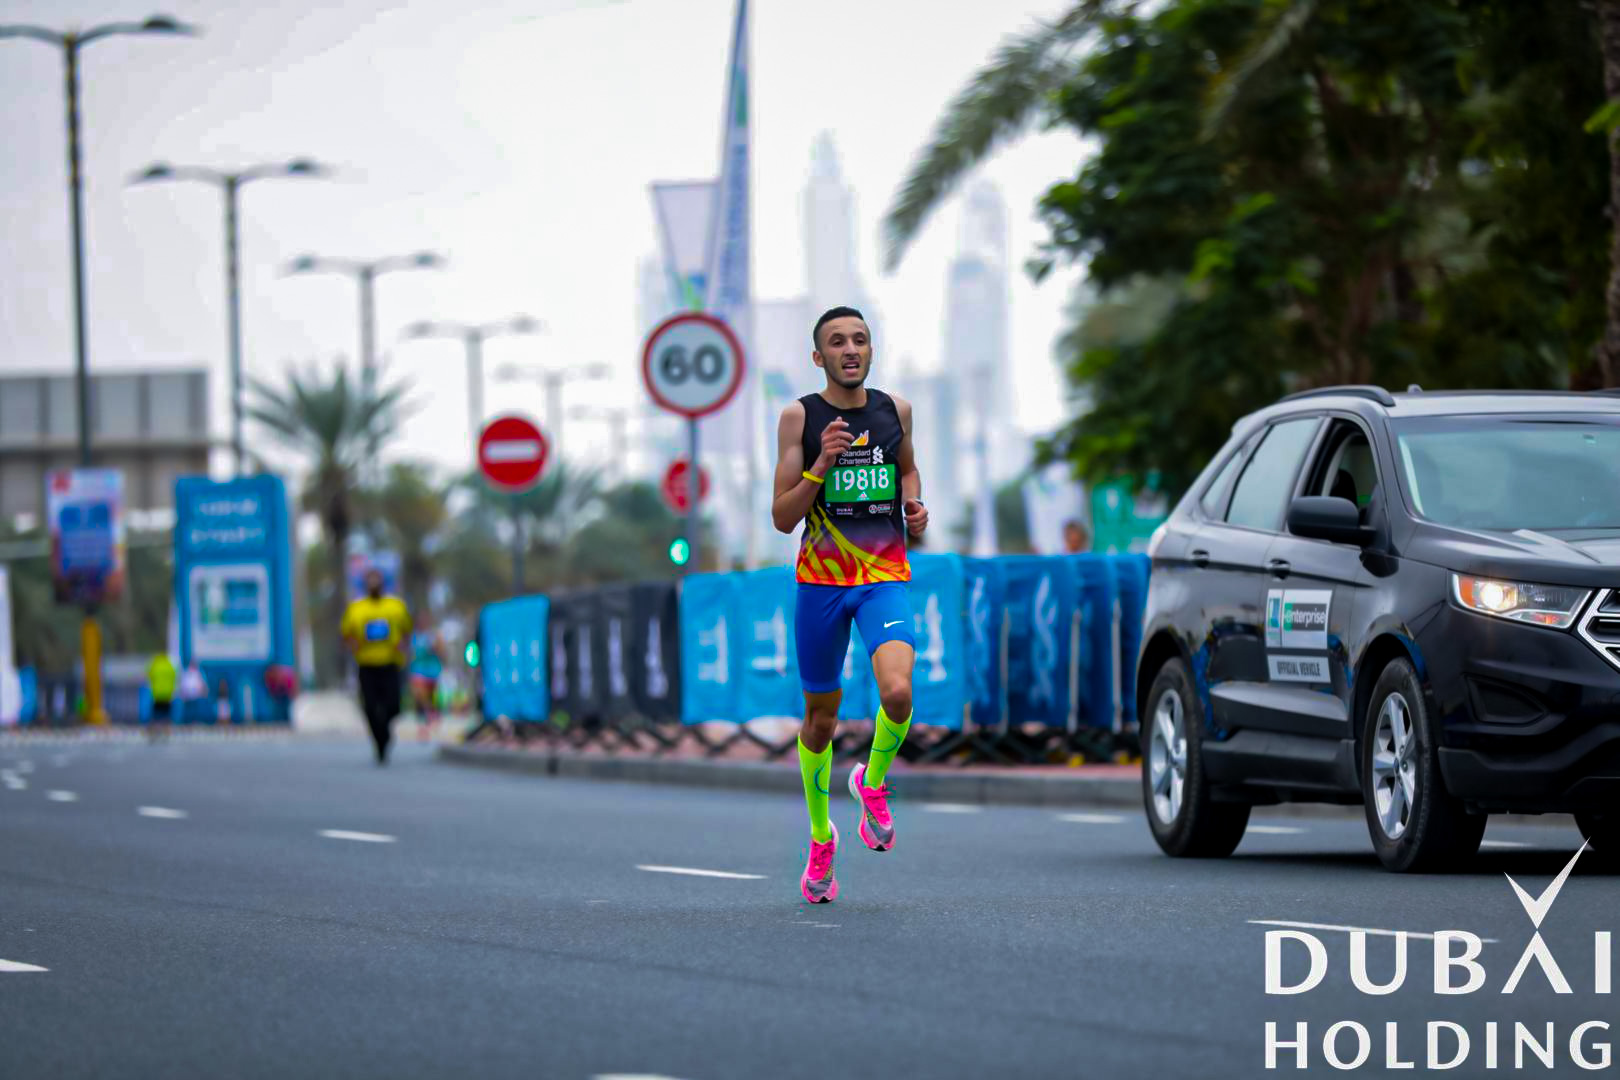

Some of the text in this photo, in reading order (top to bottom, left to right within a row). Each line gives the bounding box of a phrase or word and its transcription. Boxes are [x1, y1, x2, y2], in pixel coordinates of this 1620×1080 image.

[661, 344, 725, 385] 60
[842, 449, 871, 457] Standard
[838, 457, 871, 465] Chartered
[833, 467, 889, 491] 19818
[1299, 662, 1321, 677] VEHICLE
